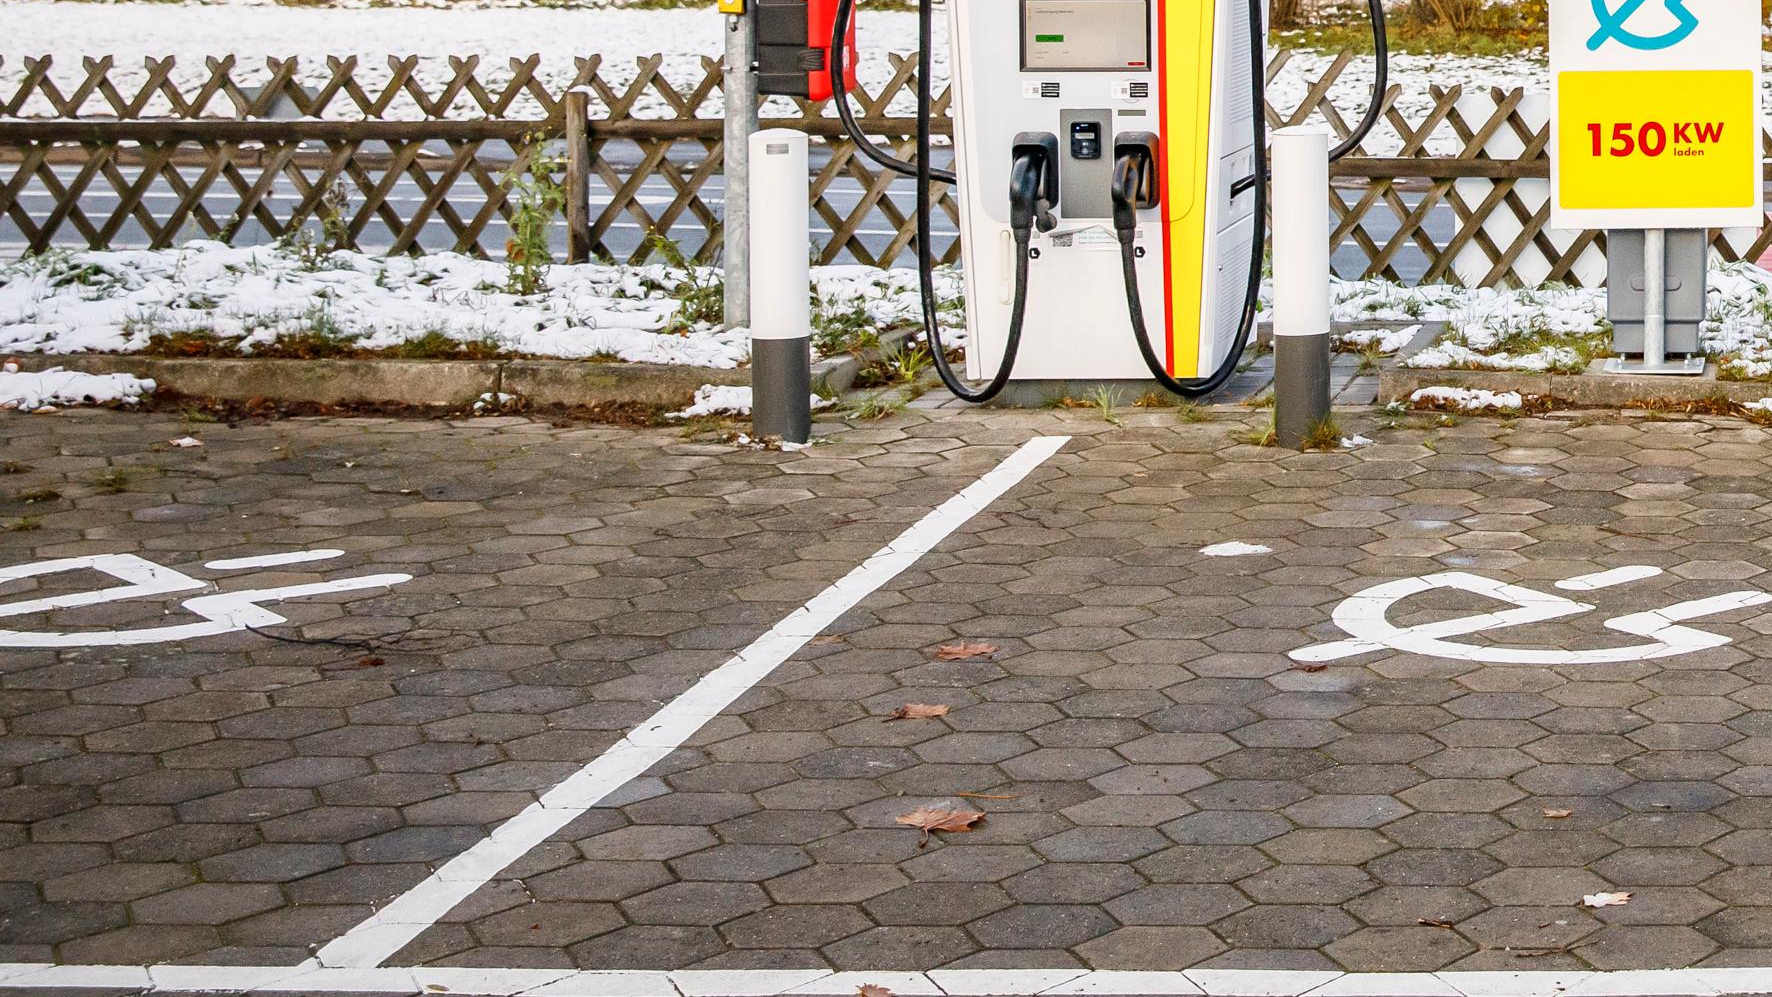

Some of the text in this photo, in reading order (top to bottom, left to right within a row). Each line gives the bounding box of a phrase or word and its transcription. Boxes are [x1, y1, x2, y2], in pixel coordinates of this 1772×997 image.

[1587, 121, 1724, 157] 150 KW
[1674, 147, 1705, 156] laden
